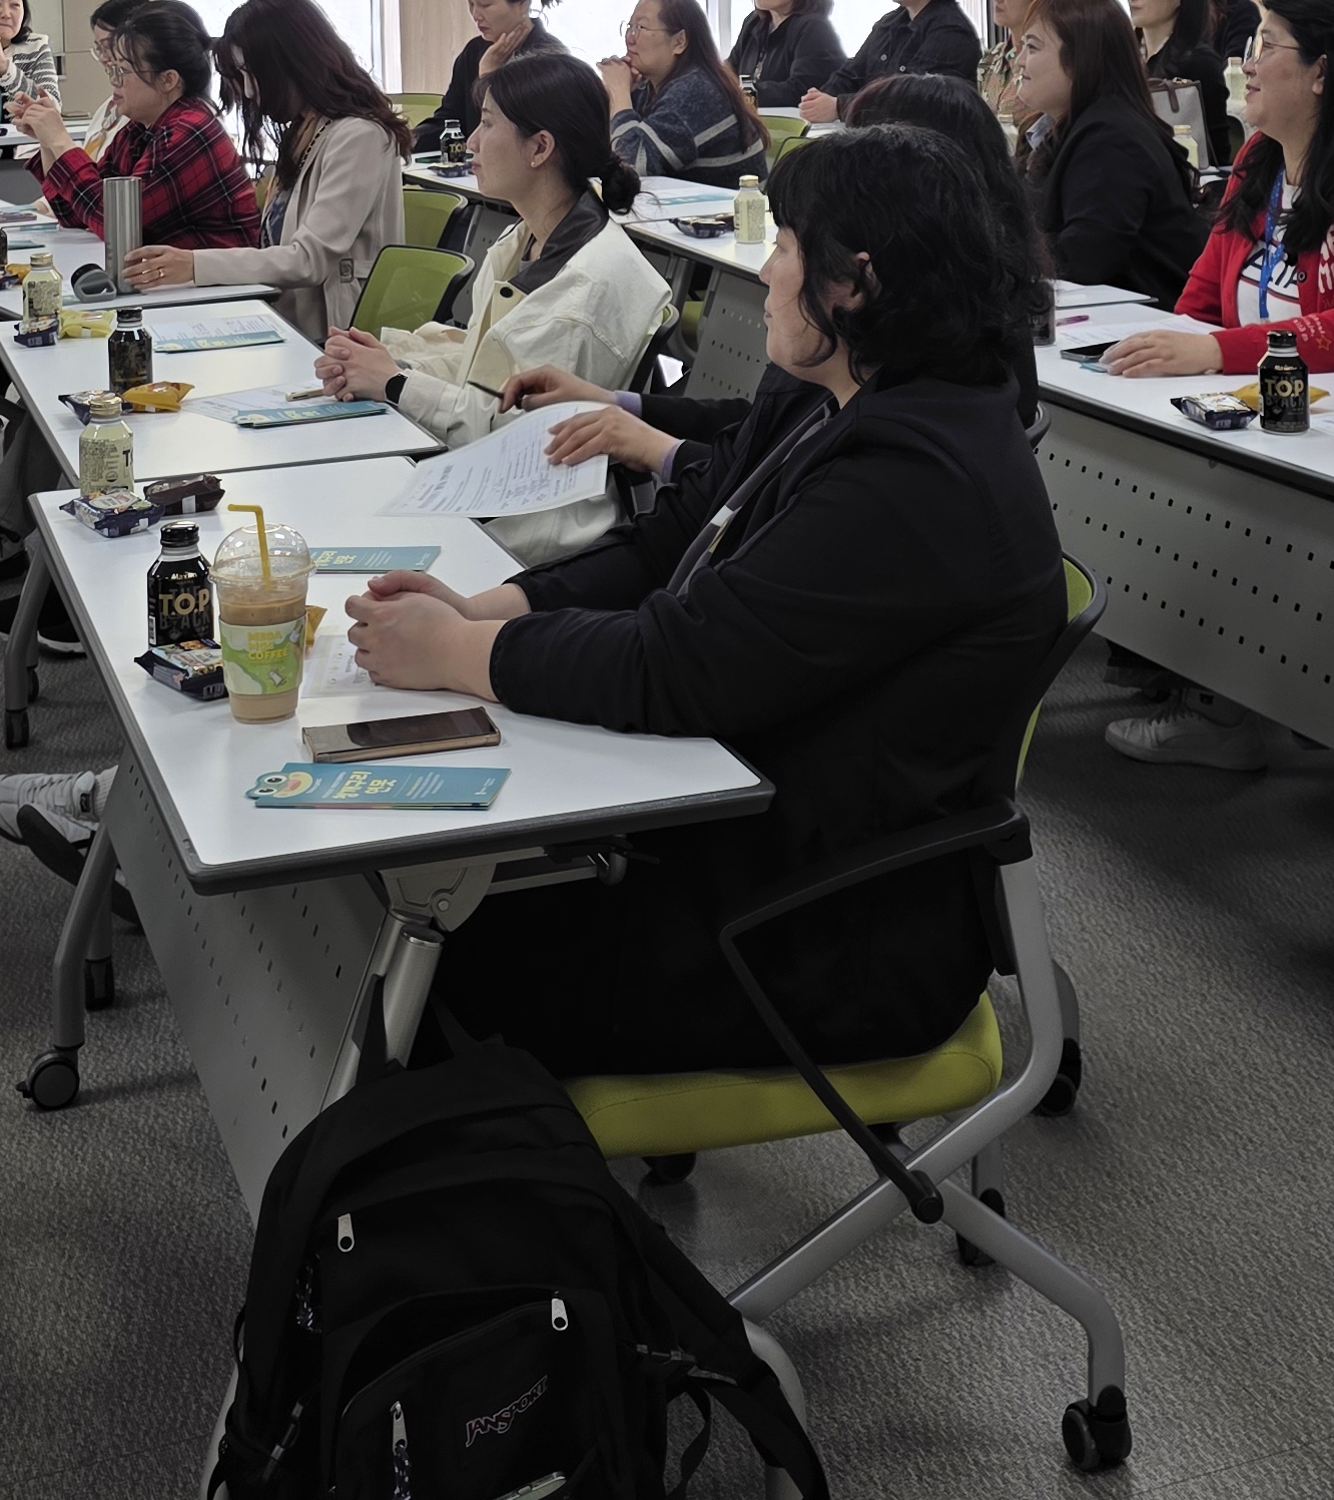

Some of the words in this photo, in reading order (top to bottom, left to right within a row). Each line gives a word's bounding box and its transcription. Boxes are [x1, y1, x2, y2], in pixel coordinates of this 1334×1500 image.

[1264, 379, 1305, 397] T.O.P
[158, 588, 210, 617] T.O.P
[248, 649, 287, 660] COFFEE
[466, 1375, 548, 1448] JANSPORT
